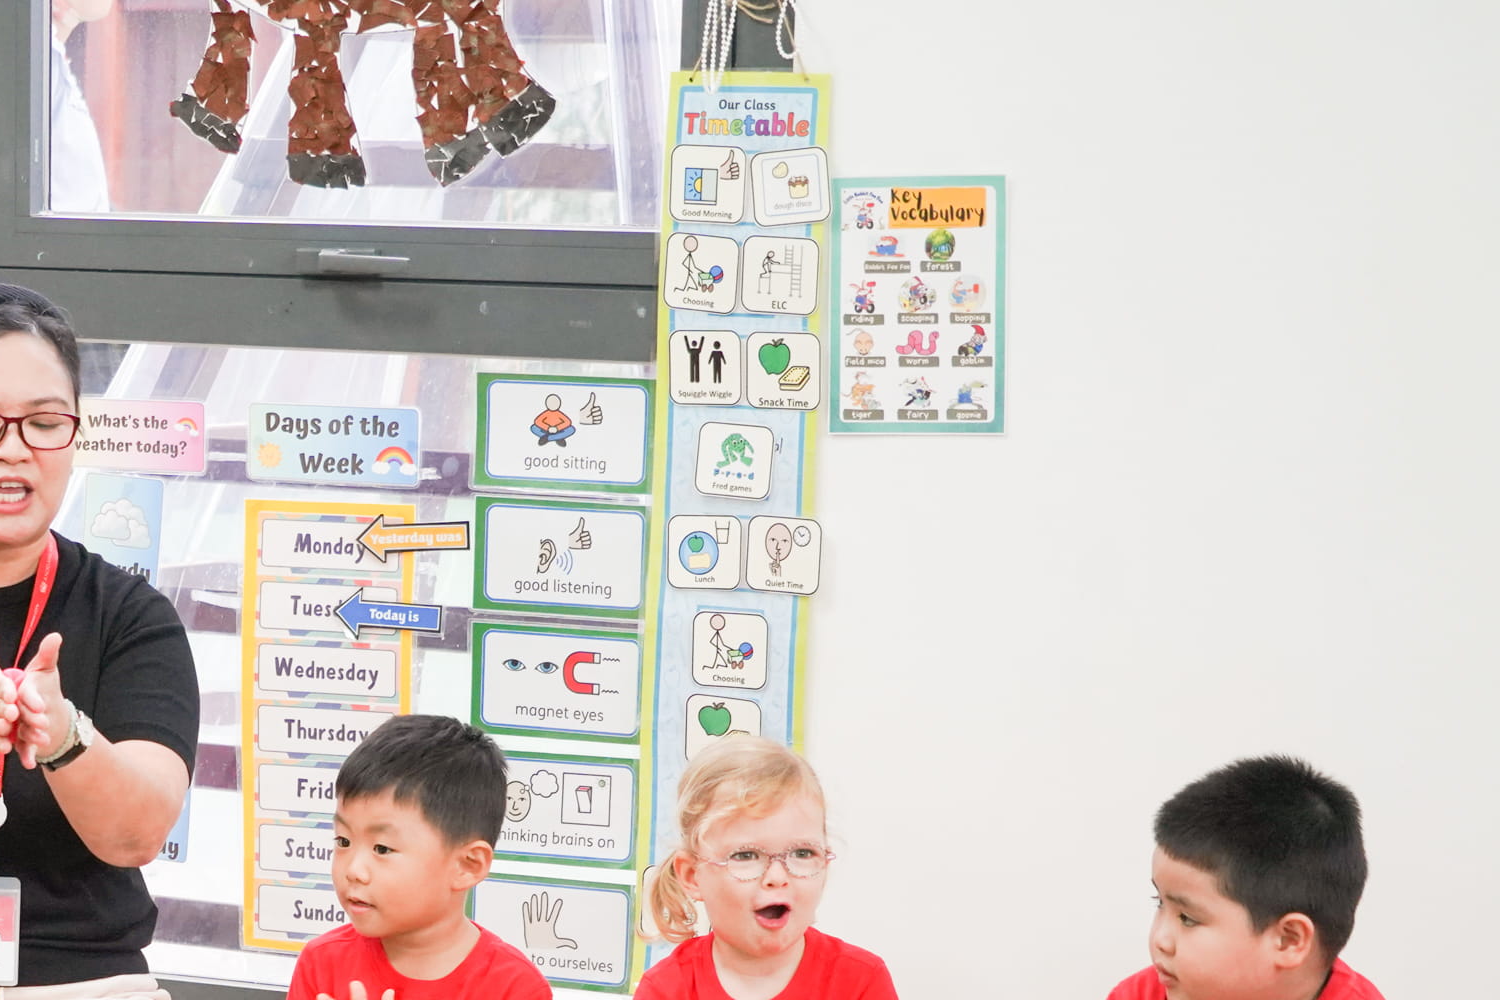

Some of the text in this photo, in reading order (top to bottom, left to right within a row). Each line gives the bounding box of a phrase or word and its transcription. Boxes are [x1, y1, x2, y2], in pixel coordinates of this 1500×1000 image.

[719, 100, 776, 110] Our Class
[684, 111, 810, 137] Timetable
[891, 188, 922, 210] Key
[682, 209, 732, 220] Good Morning
[890, 204, 984, 228] Vocabulary
[926, 262, 954, 271] forest
[683, 297, 714, 308] Choosing
[772, 301, 787, 310] ELC
[851, 315, 874, 324] riding
[955, 315, 985, 324] bopping
[678, 390, 732, 398] Squiggle Wiggle
[759, 398, 809, 408] Snack Time
[88, 414, 168, 430] What's the
[852, 411, 872, 419] tiger
[906, 411, 929, 420] fairy
[264, 412, 400, 440] Days of the
[136, 440, 188, 458] today?
[300, 452, 364, 476] Week
[524, 455, 607, 474] good sitting
[712, 482, 752, 493] Fred games
[370, 531, 462, 546] Yesterday was
[294, 533, 366, 564] Monday
[514, 579, 612, 599] good listening
[765, 579, 804, 590] Quiet Time
[291, 595, 332, 617] Tues
[370, 608, 419, 624] Today is
[275, 656, 379, 690] Wednesday
[712, 674, 745, 684] Choosing
[516, 705, 604, 724] magnet eyes
[284, 718, 368, 743] Thursday
[297, 778, 336, 800] Frid
[500, 828, 615, 849] hinking brains on
[284, 838, 333, 861] Satur
[293, 900, 345, 923] Sunda
[531, 954, 613, 973] to ourselves
